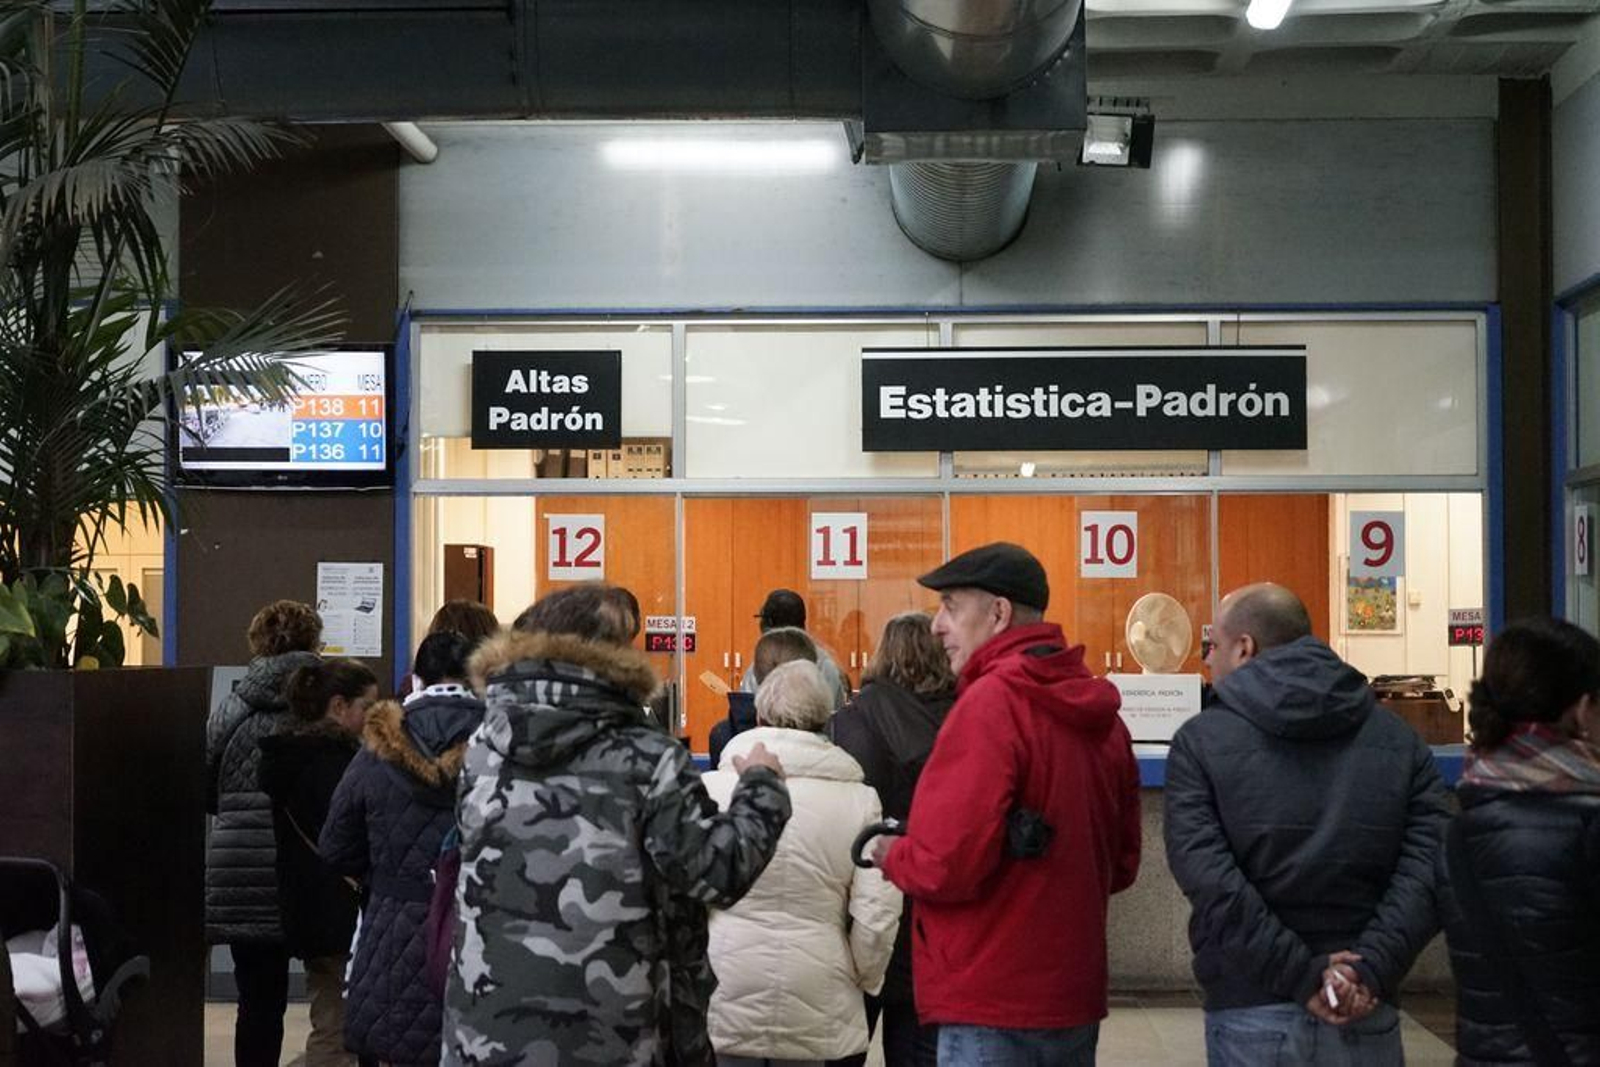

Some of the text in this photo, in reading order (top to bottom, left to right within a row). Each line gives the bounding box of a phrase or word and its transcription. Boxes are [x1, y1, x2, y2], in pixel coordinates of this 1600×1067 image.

[358, 374, 383, 391] MESA
[504, 369, 589, 394] Altas
[292, 398, 380, 415] P138 11
[879, 384, 1290, 419] Estatística-Padrón
[292, 422, 382, 438] P137 10
[489, 406, 604, 431] Padrón
[292, 444, 381, 460] P136 11
[551, 526, 601, 567] 12
[815, 526, 863, 566] 11
[1083, 524, 1135, 566] 10
[1361, 520, 1394, 567] 9
[1578, 515, 1585, 565] 8
[1452, 611, 1482, 621] MESA
[1455, 628, 1485, 641] P13
